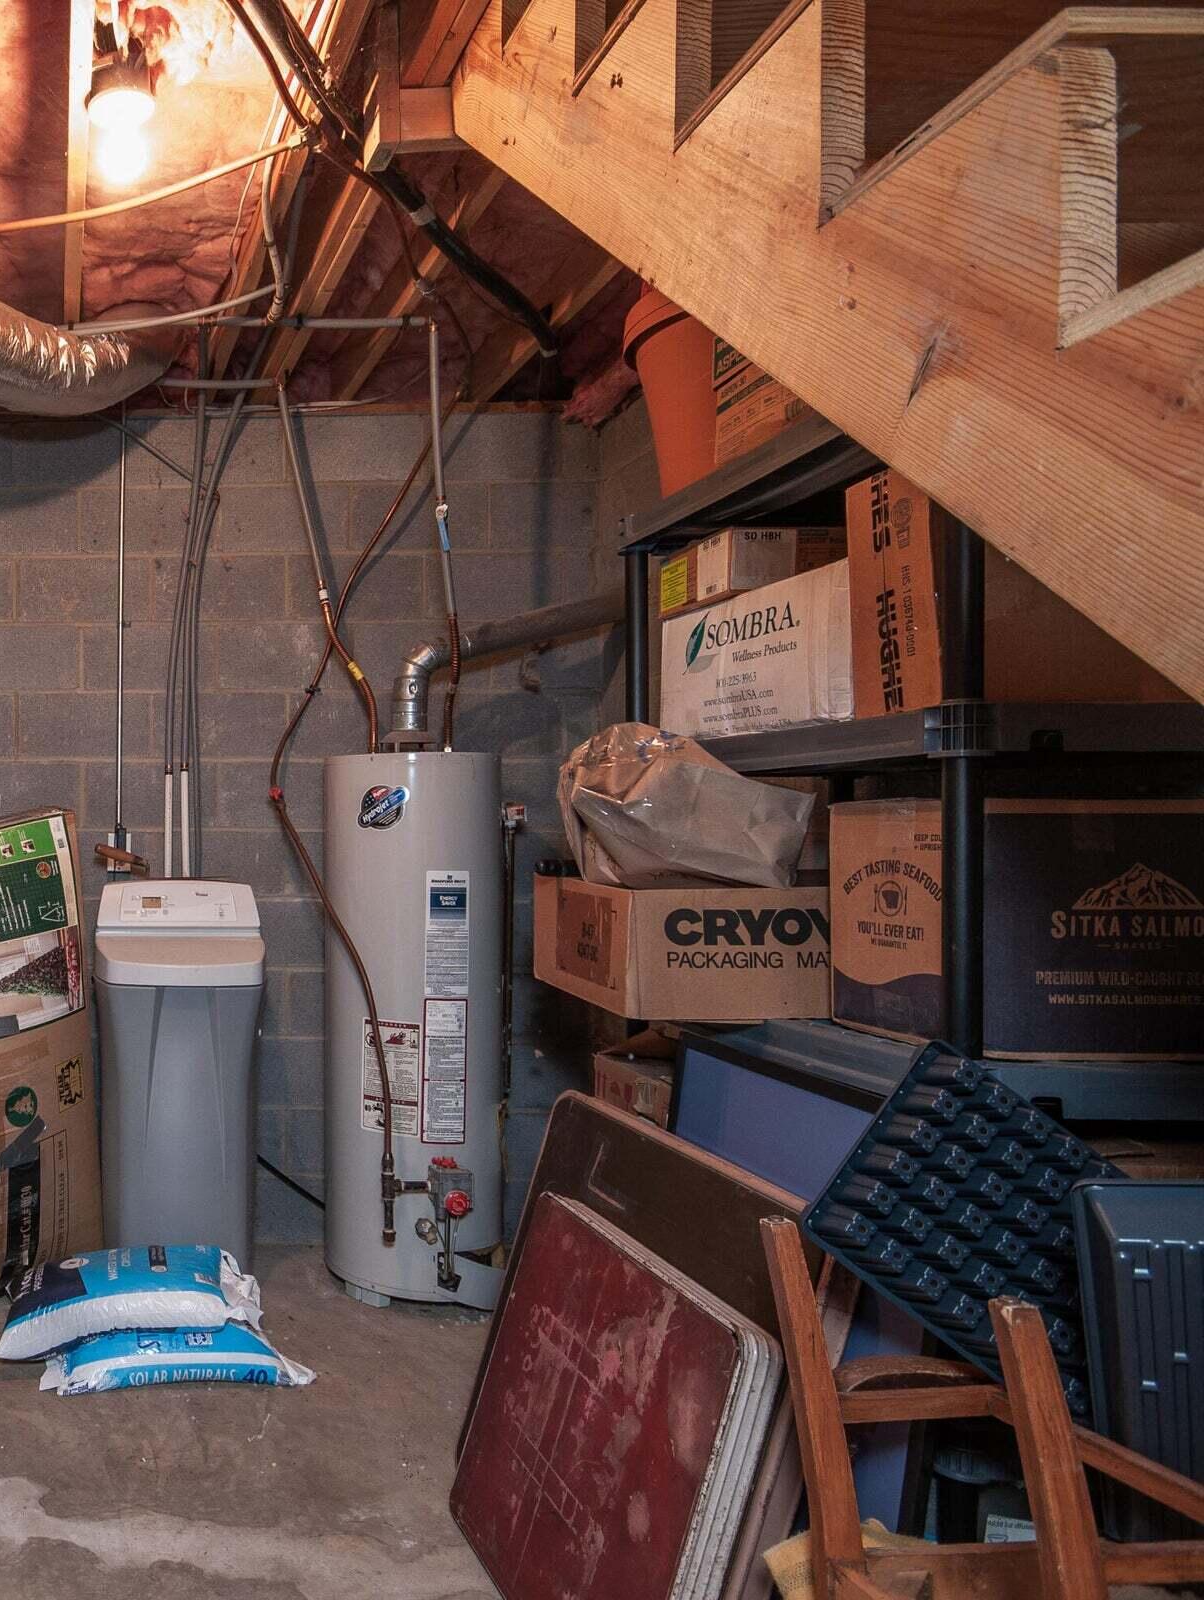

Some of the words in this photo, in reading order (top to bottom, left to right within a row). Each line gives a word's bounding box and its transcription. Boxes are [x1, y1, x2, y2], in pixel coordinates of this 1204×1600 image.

[744, 531, 757, 540] SD
[761, 531, 782, 541] HBH
[732, 647, 762, 663] Wellness
[763, 640, 797, 657] Products
[914, 833, 929, 841] KEEP
[920, 843, 941, 851] UPRIGH
[843, 869, 862, 895] BEST
[863, 859, 901, 878] TASTING
[902, 862, 943, 902] SEAFOOD
[857, 920, 883, 936] YOU'LL
[884, 923, 904, 939] EVER
[906, 926, 924, 941] EAT!
[1131, 915, 1204, 938] SALMO
[667, 951, 783, 968] PACKAGING
[797, 951, 830, 968] MA
[1036, 971, 1094, 986] PREMIUM
[129, 1370, 169, 1385] SOLAR
[173, 1368, 237, 1384] NATURALS
[242, 1368, 269, 1385] 40
